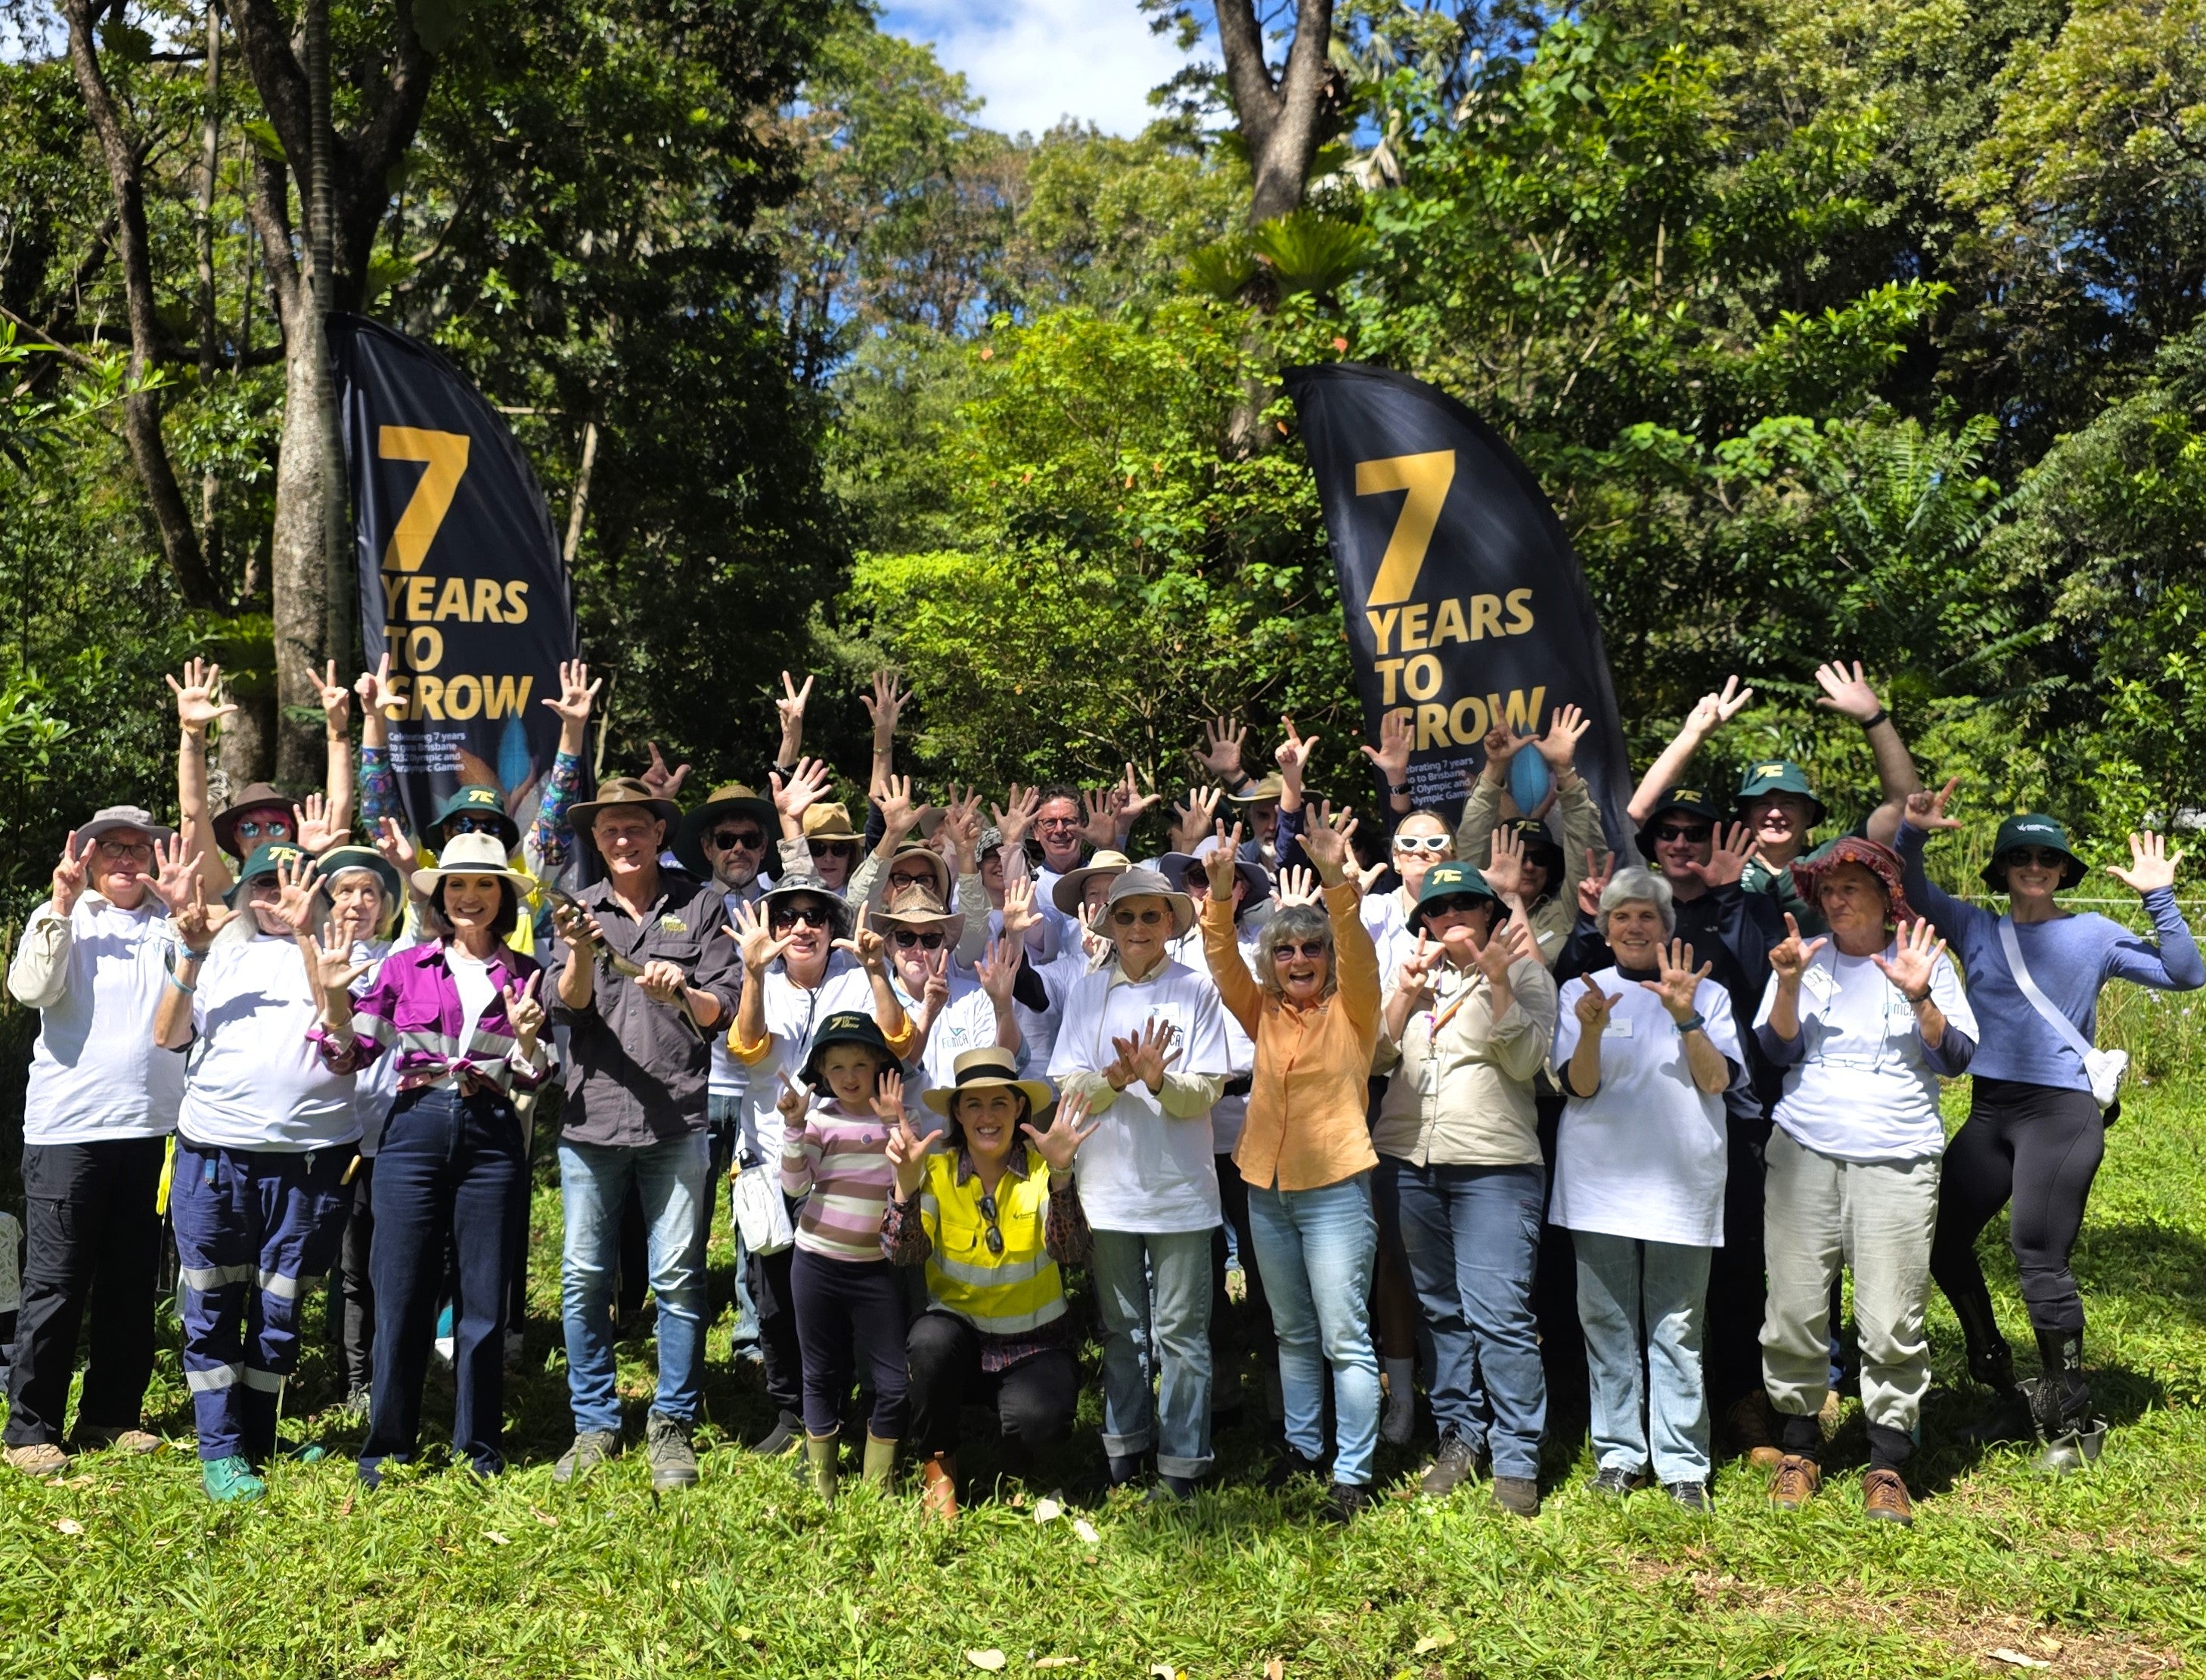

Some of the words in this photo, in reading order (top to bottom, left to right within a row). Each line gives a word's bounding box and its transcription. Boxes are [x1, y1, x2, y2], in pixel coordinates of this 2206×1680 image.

[379, 425, 470, 572] 7
[1355, 449, 1455, 607] 7
[380, 574, 529, 625] YEARS
[1366, 588, 1534, 655] YEARS
[383, 625, 443, 672] TO
[1374, 654, 1443, 705] TO
[384, 674, 533, 721] GROW
[433, 732, 439, 740] 7
[441, 733, 466, 742] years
[417, 742, 457, 752] Brisbane
[443, 752, 461, 761] and
[1450, 758, 1474, 769] years
[433, 763, 465, 772] Games
[1428, 769, 1466, 781] Brisbane
[1417, 782, 1451, 794] Olympic
[1454, 777, 1471, 787] and
[830, 1017, 842, 1031] 7
